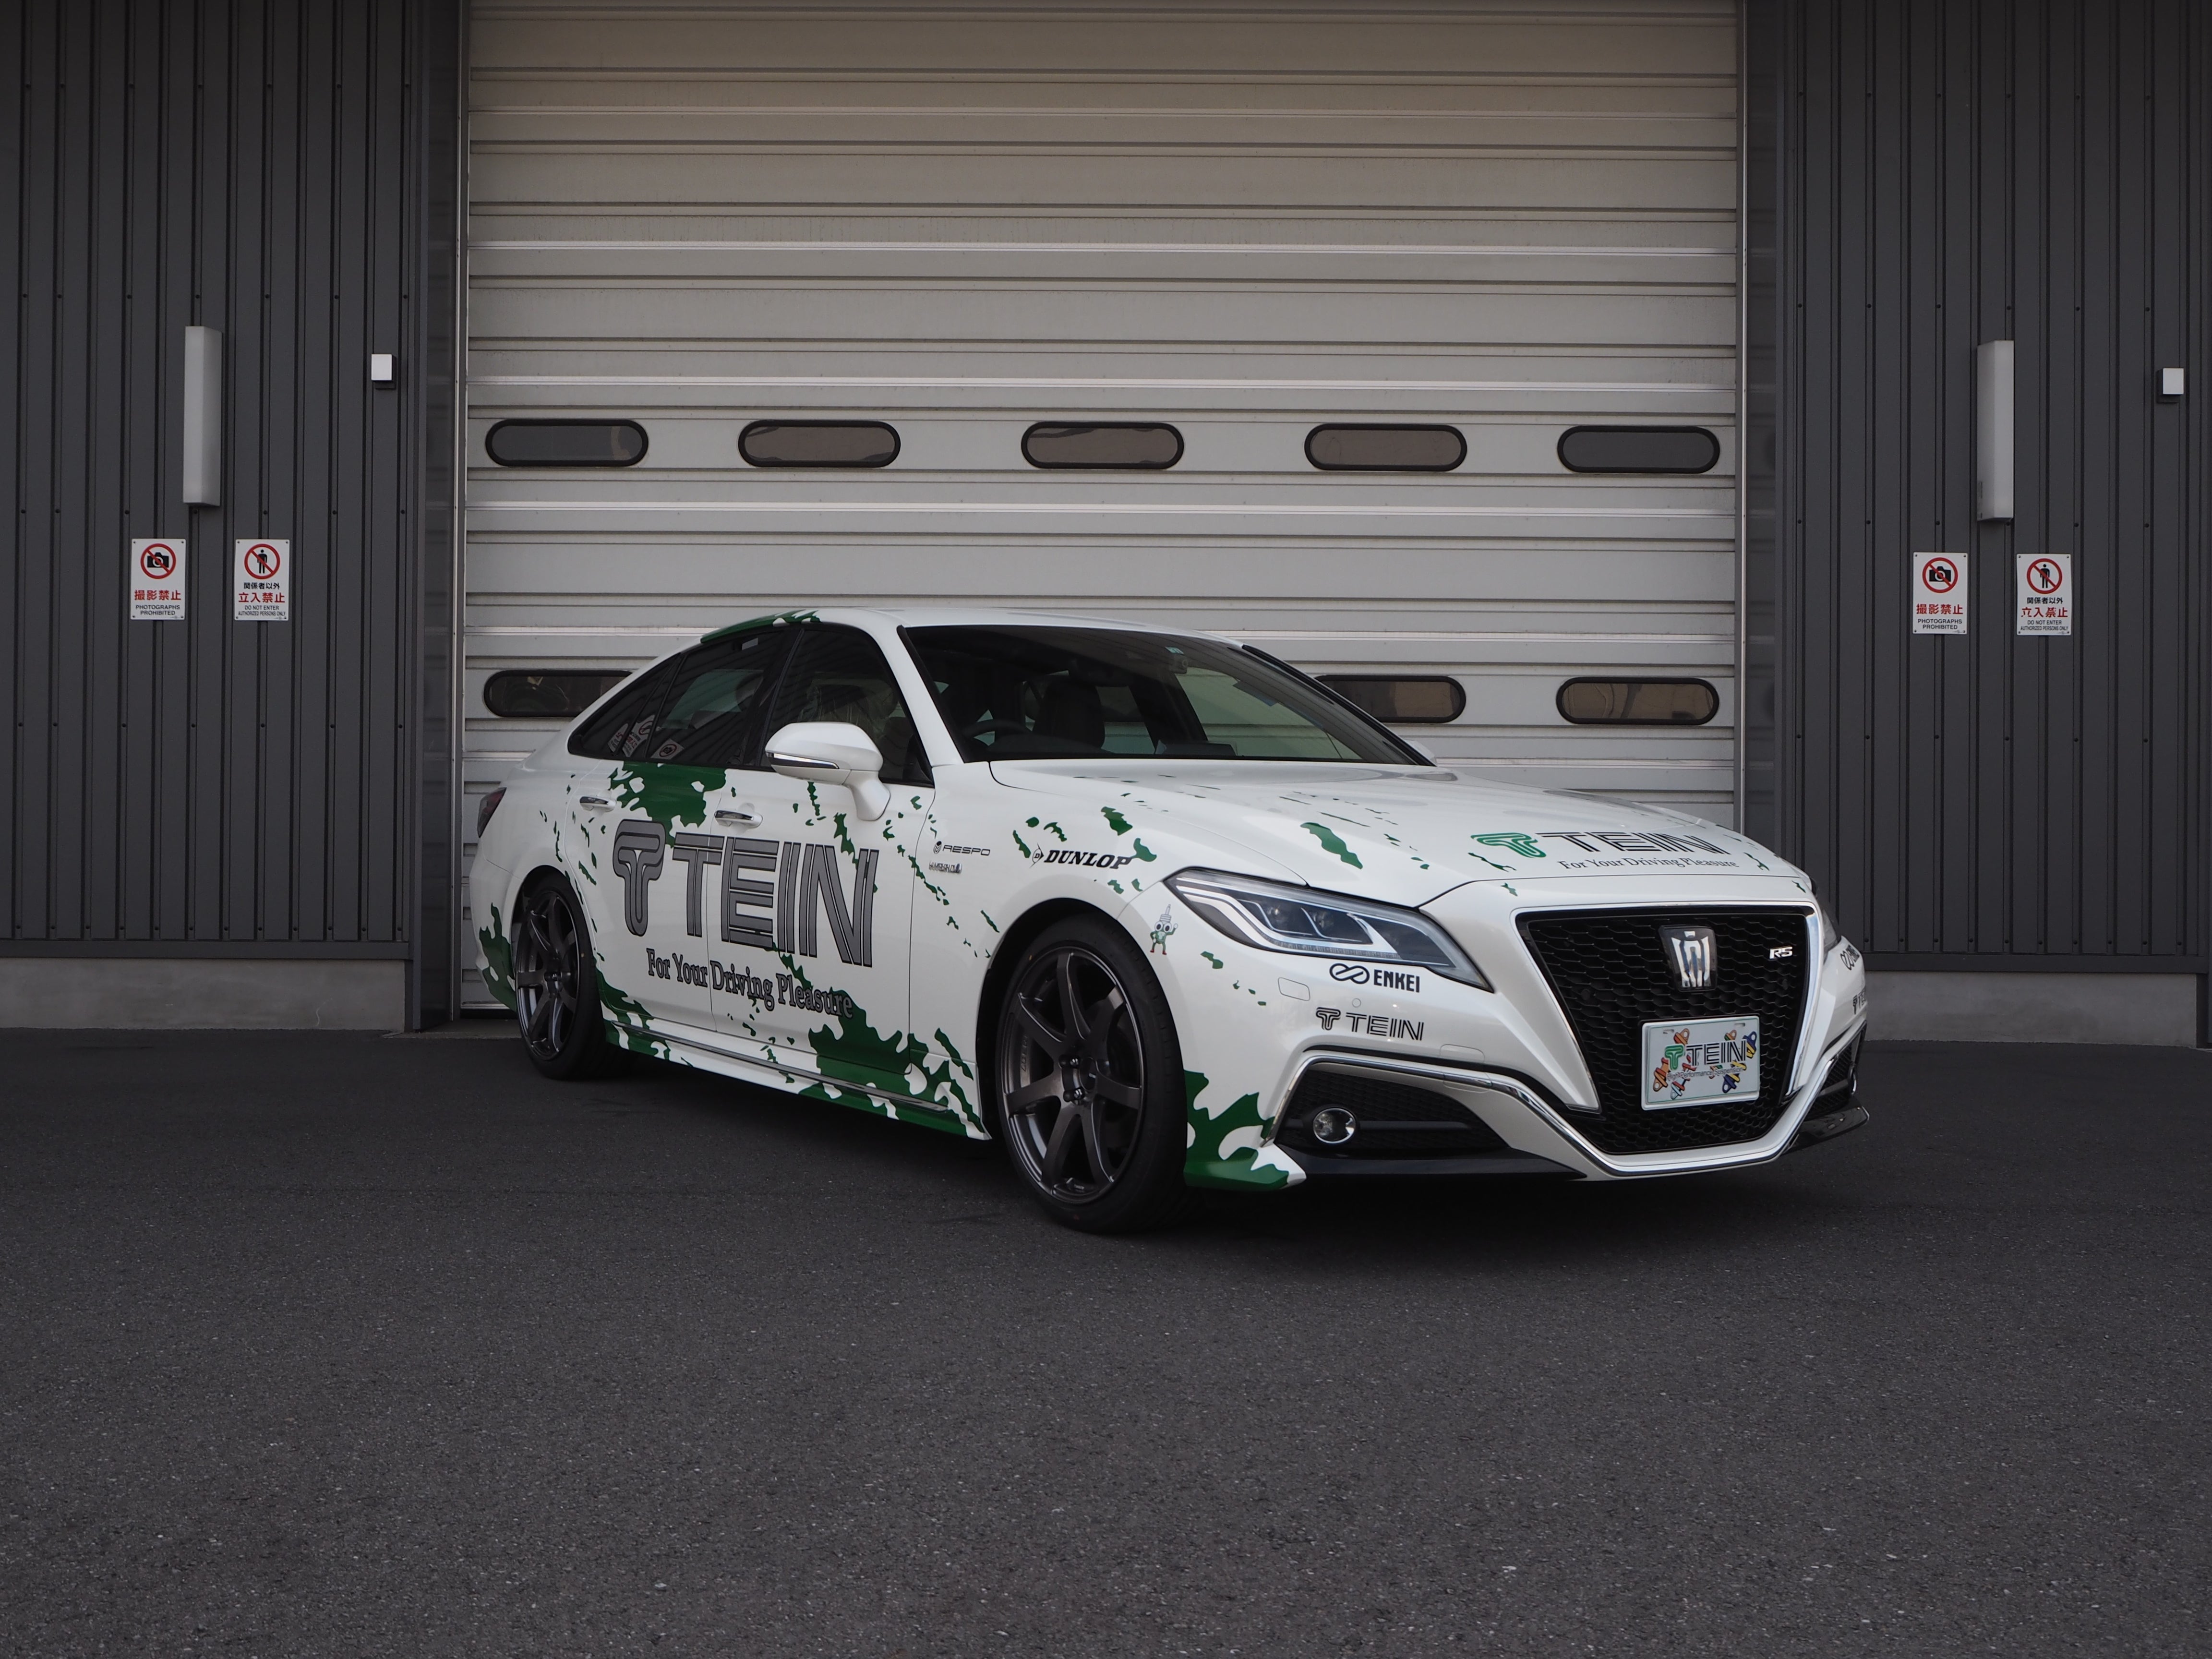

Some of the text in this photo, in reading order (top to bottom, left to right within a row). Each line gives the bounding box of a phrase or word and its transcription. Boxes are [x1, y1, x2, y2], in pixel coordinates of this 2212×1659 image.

[134, 589, 181, 601] 撮影禁止
[239, 592, 285, 603] 立入禁止
[1916, 603, 1963, 615] 撮影禁止
[2021, 607, 2068, 618] 立入禁止
[942, 844, 991, 856] RESPO
[1535, 832, 1732, 855] TEIN
[1044, 849, 1132, 869] DUNLOP
[1557, 857, 1740, 869] For Your Driving Pleasure
[672, 831, 880, 968] TEIN
[1770, 946, 1793, 960] RS
[646, 948, 853, 1019] For Your Driving Pleasure
[1373, 969, 1420, 993] ENKEI
[1346, 1011, 1424, 1041] TEIN
[1686, 1039, 1746, 1067] TEIN
[1667, 1067, 1743, 1081] High Performance Suspension
